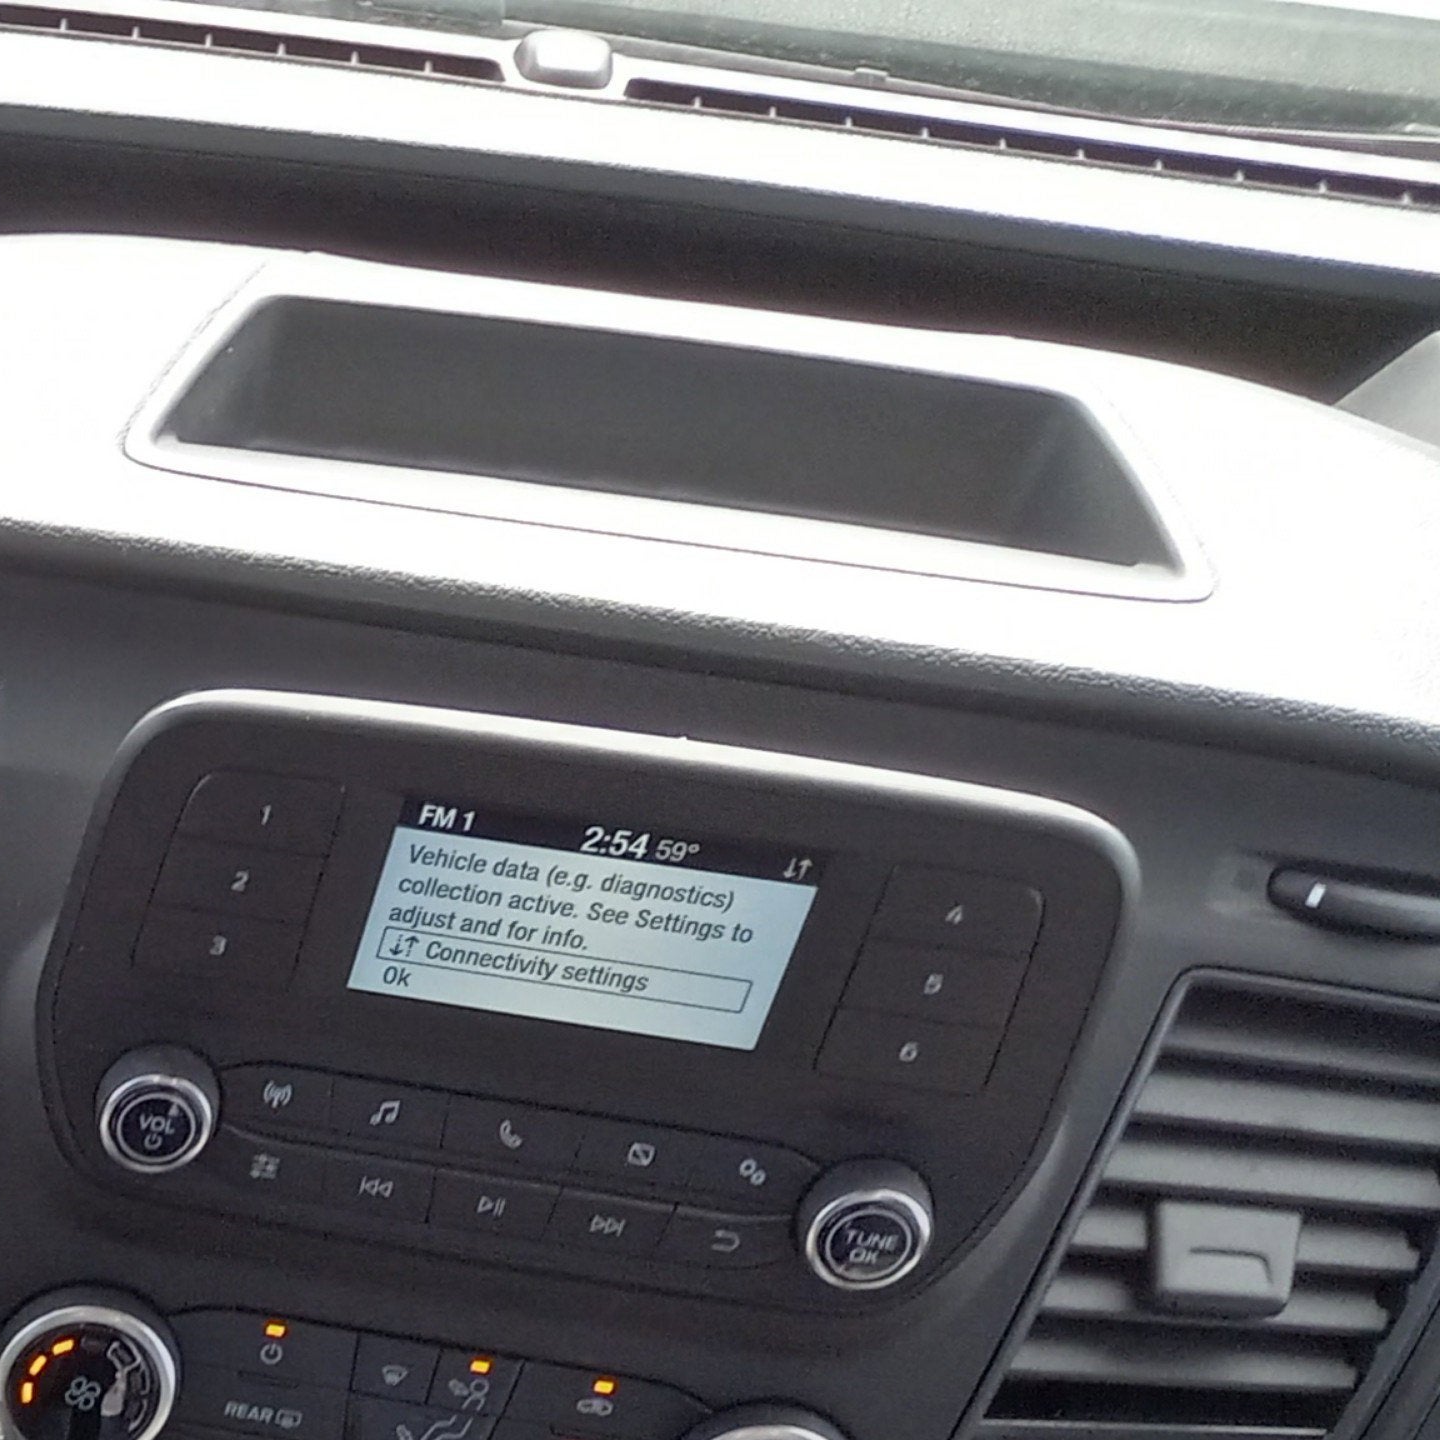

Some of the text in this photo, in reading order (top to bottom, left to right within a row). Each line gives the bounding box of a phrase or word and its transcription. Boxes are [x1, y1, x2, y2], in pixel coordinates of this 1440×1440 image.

[260, 804, 272, 826] 1
[418, 804, 476, 832] FM 1
[580, 825, 651, 859] 2:54
[231, 869, 250, 892] 2
[409, 844, 735, 914] Vehicle data (e.g. diagnostics)
[398, 877, 754, 944] collection active. See Settings to
[388, 905, 590, 951] adjust and for info.
[382, 964, 412, 988] Ok
[425, 940, 650, 994] Connectivity settings
[139, 1114, 175, 1135] VOL
[845, 1229, 899, 1252] TUNE
[223, 1401, 273, 1424] REAR
